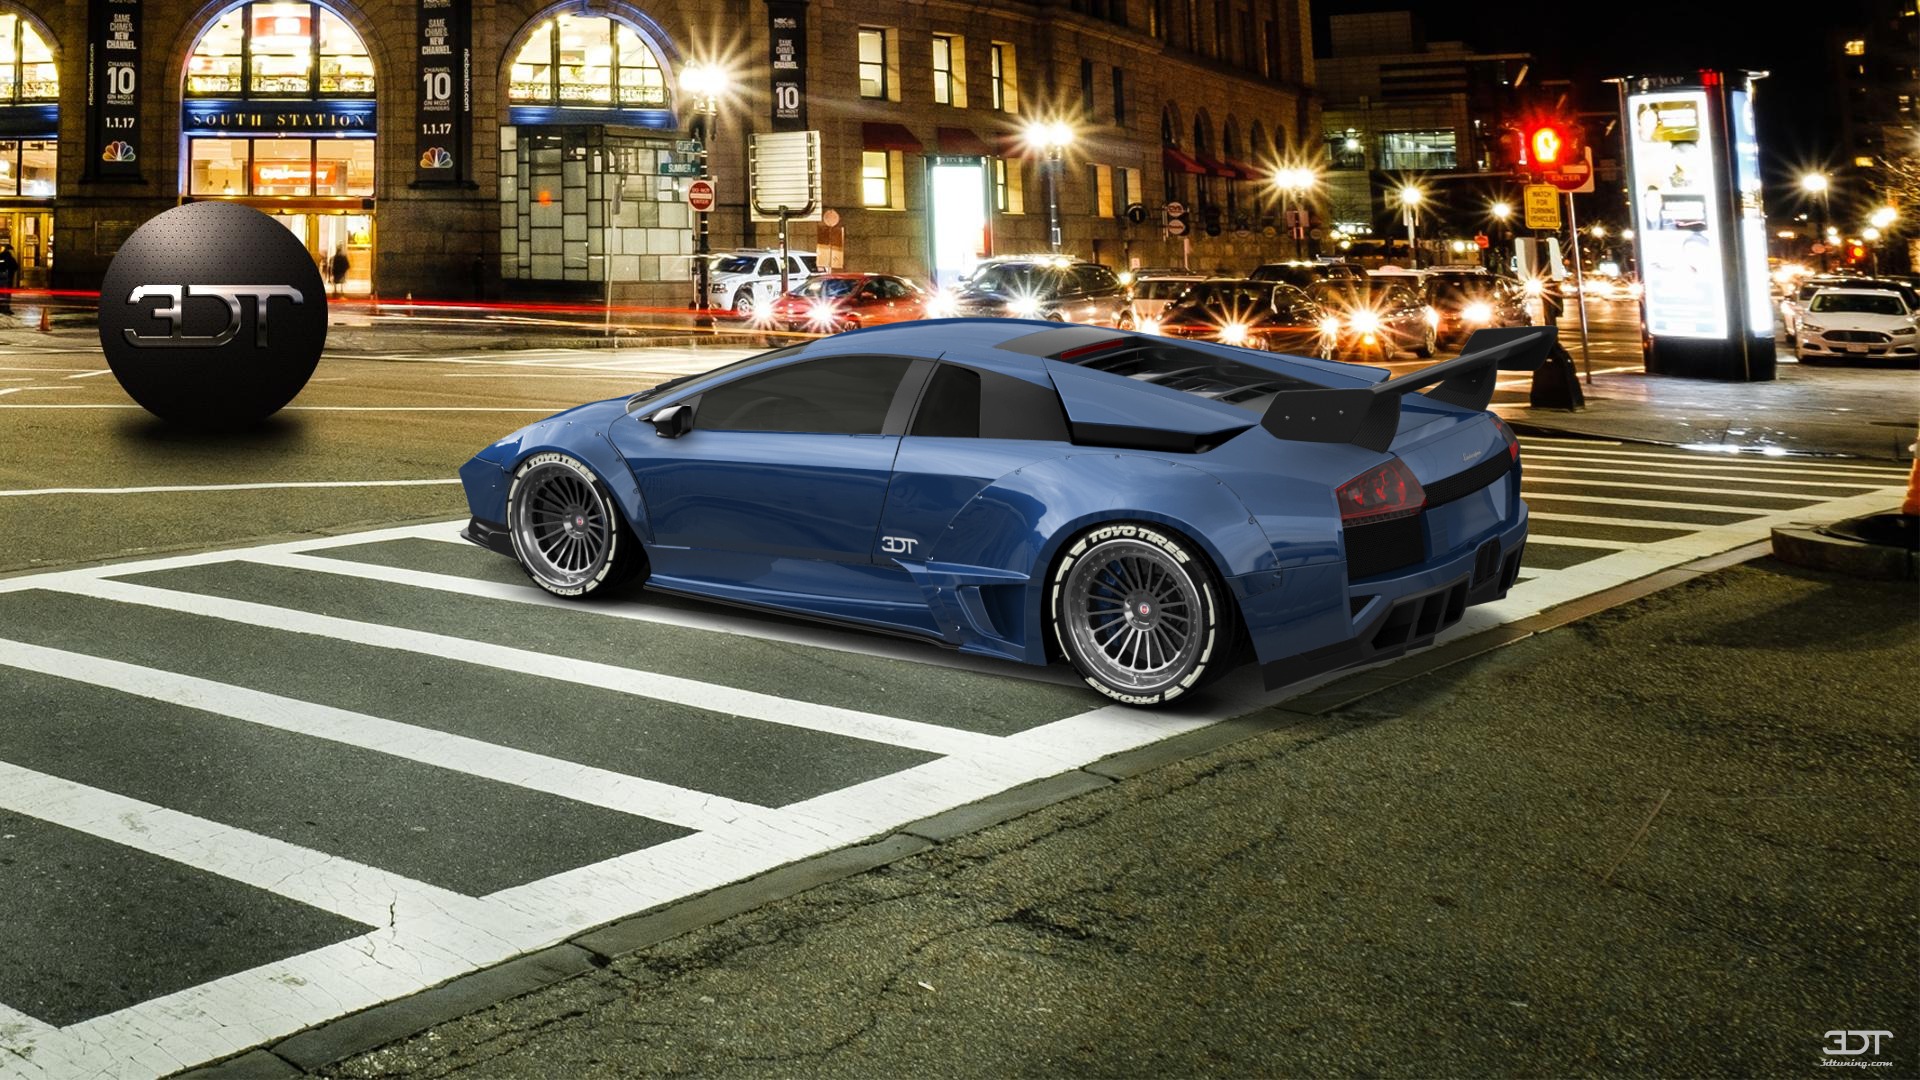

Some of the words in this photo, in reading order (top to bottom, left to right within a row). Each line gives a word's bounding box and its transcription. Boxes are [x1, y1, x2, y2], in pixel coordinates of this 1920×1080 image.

[113, 14, 131, 22] SAME
[428, 19, 445, 28] SAME
[114, 32, 130, 40] NEW
[429, 37, 445, 46] NEW
[107, 66, 136, 95] 10
[423, 72, 452, 101] 10
[463, 48, 471, 112] nbcboston.com
[775, 86, 799, 109] 10
[105, 117, 135, 129] 1.1.17
[192, 113, 262, 127] SOUTH
[276, 113, 366, 127] STATION
[422, 123, 452, 135] 1.1.17
[667, 163, 692, 173] SUMMER
[1551, 174, 1581, 182] ENTER
[123, 284, 304, 348] 3DT
[528, 453, 561, 468] TOYO
[560, 454, 598, 483] TIRES
[881, 535, 919, 555] 3DT
[1088, 525, 1138, 543] TOYO
[1137, 527, 1191, 565] TIRES
[1085, 676, 1161, 705] PROXES
